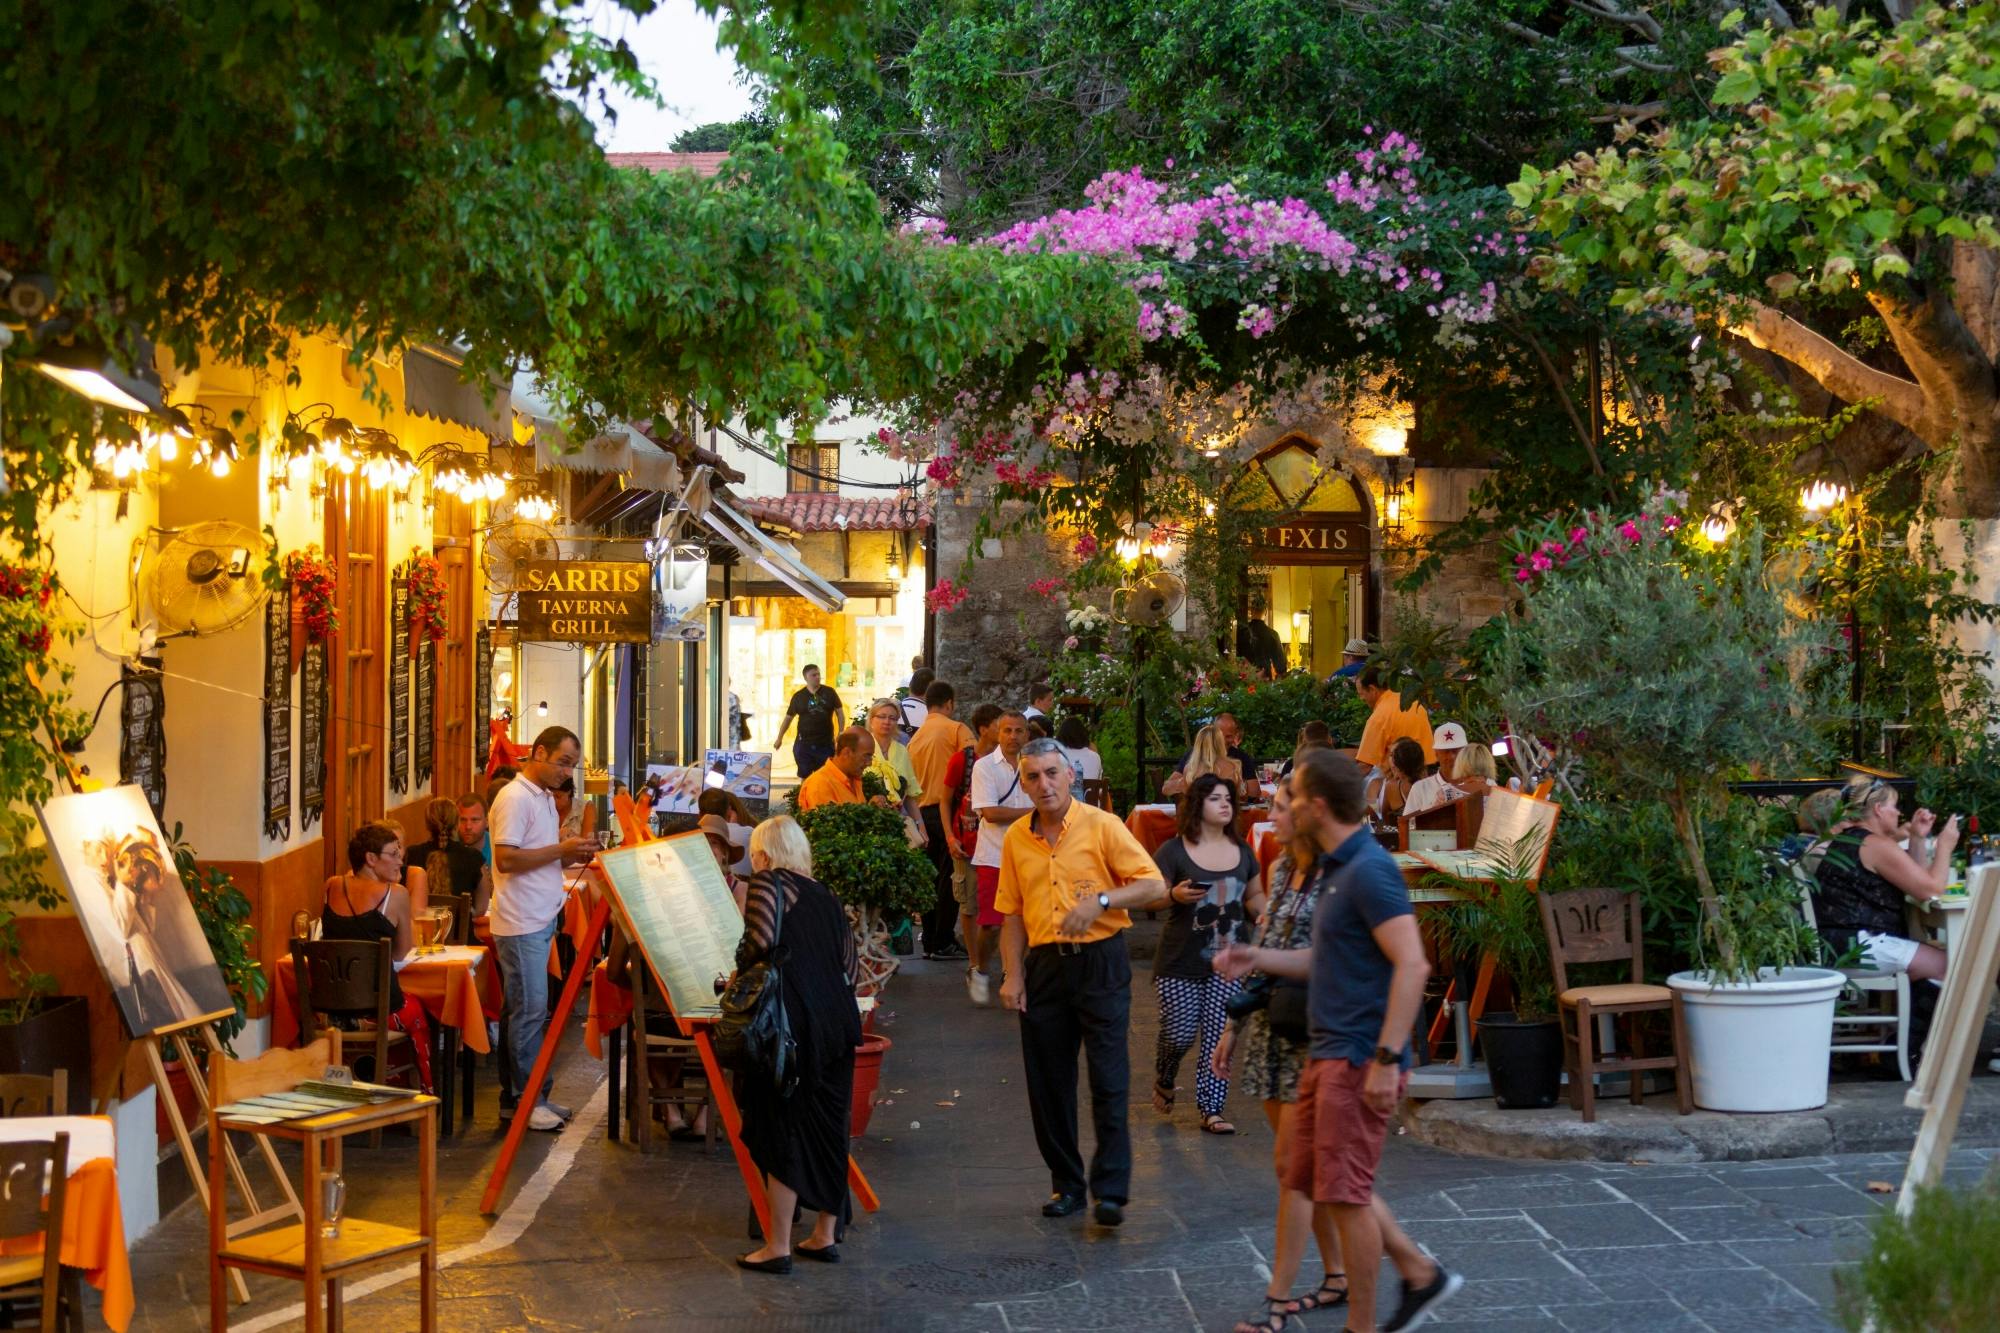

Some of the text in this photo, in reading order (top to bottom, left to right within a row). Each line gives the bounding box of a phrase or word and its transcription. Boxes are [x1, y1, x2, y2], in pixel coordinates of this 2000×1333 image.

[528, 569, 640, 592] SARRIS
[538, 599, 629, 615] TAVERNA
[551, 619, 616, 634] GRILL
[327, 1069, 344, 1079] 20
